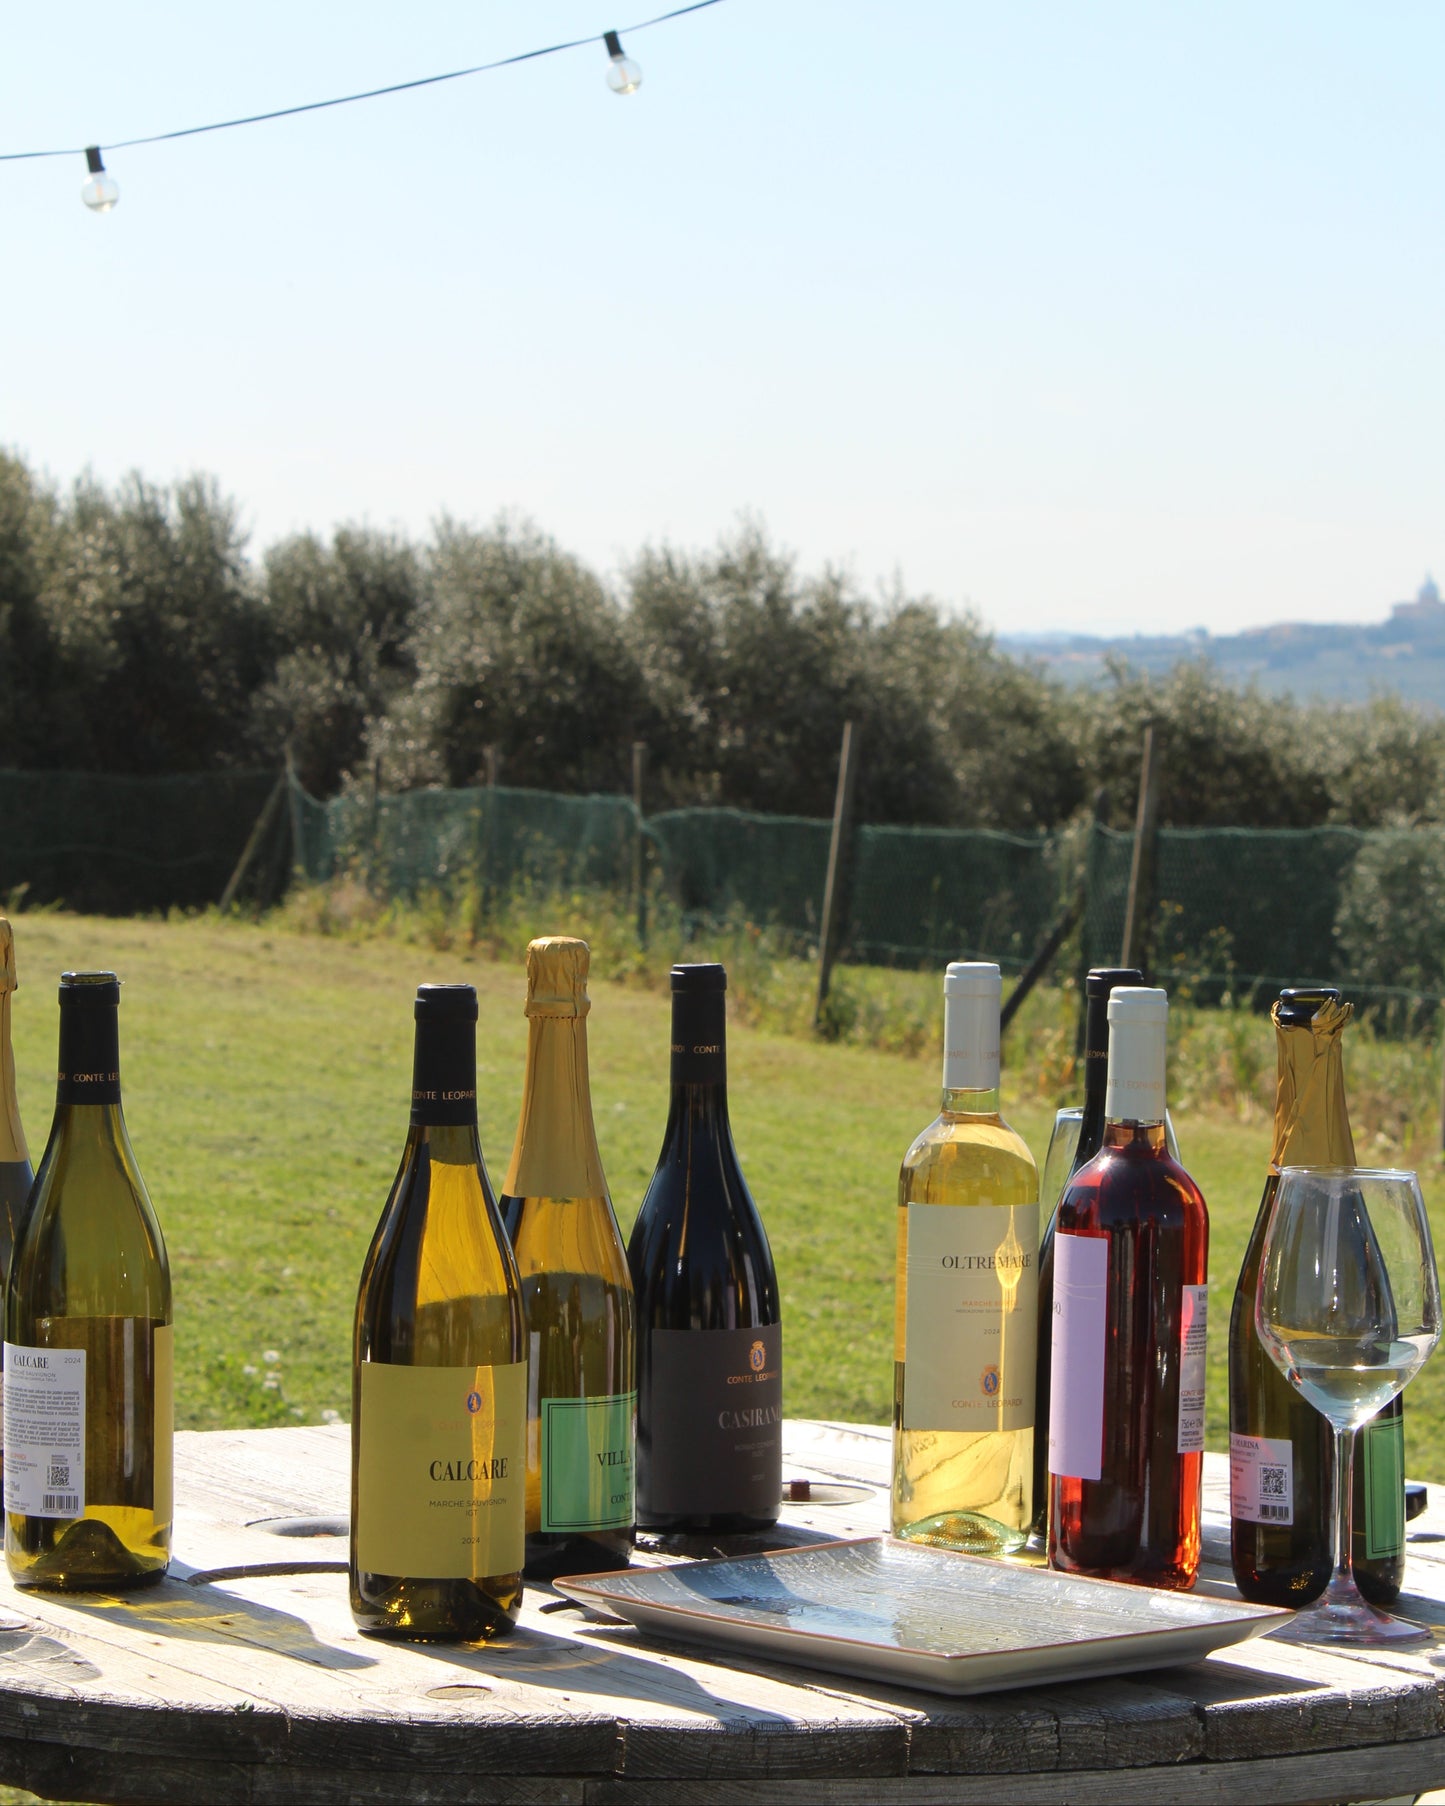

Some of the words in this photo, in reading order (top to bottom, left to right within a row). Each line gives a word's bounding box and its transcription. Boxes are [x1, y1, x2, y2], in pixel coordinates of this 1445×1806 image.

[73, 1073, 105, 1082] CONTE
[942, 1254, 1032, 1270] OLTREMARE
[13, 1354, 49, 1370] CALCARE
[727, 1374, 753, 1384] CONTE
[951, 1400, 983, 1408] CONTE
[987, 1399, 1023, 1408] LEOPARDI
[429, 1457, 509, 1482] CALCARE
[428, 1500, 465, 1508] MARCHE
[465, 1497, 507, 1507] SAUVIGNON
[465, 1509, 478, 1517] IGT
[461, 1537, 481, 1545] 2024
